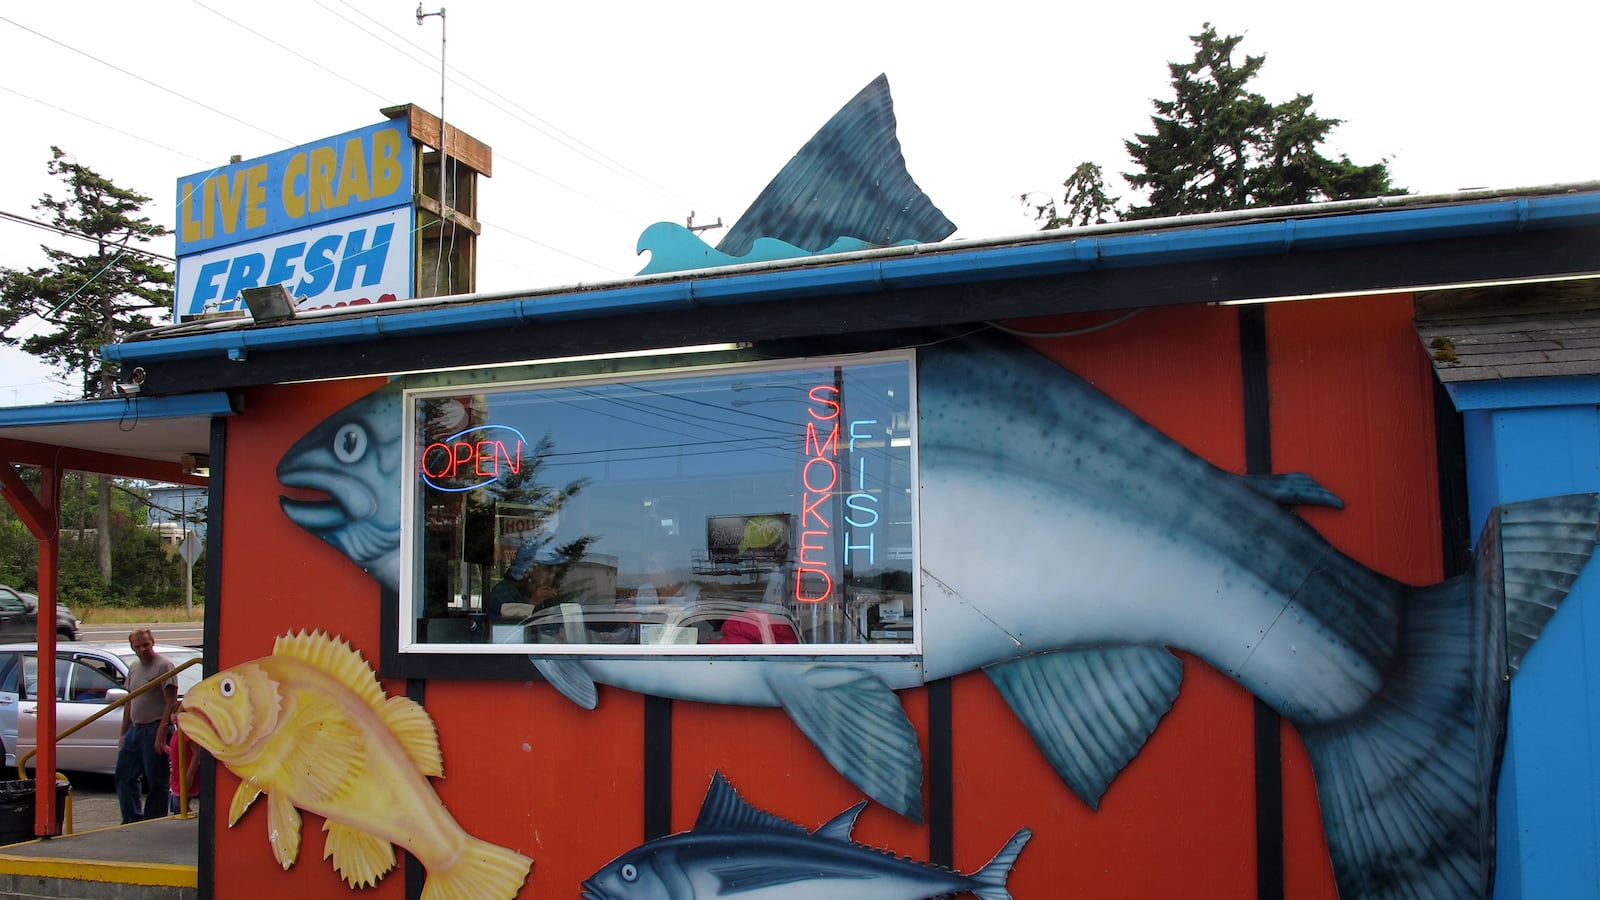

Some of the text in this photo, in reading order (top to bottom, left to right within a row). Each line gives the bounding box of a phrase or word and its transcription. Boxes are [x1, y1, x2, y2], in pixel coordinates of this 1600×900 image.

[181, 127, 404, 244] LIVE CRAB
[188, 222, 396, 314] FRESH
[421, 439, 523, 479] OPEN
[795, 384, 841, 603] SMOKED
[844, 419, 880, 566] FISH
